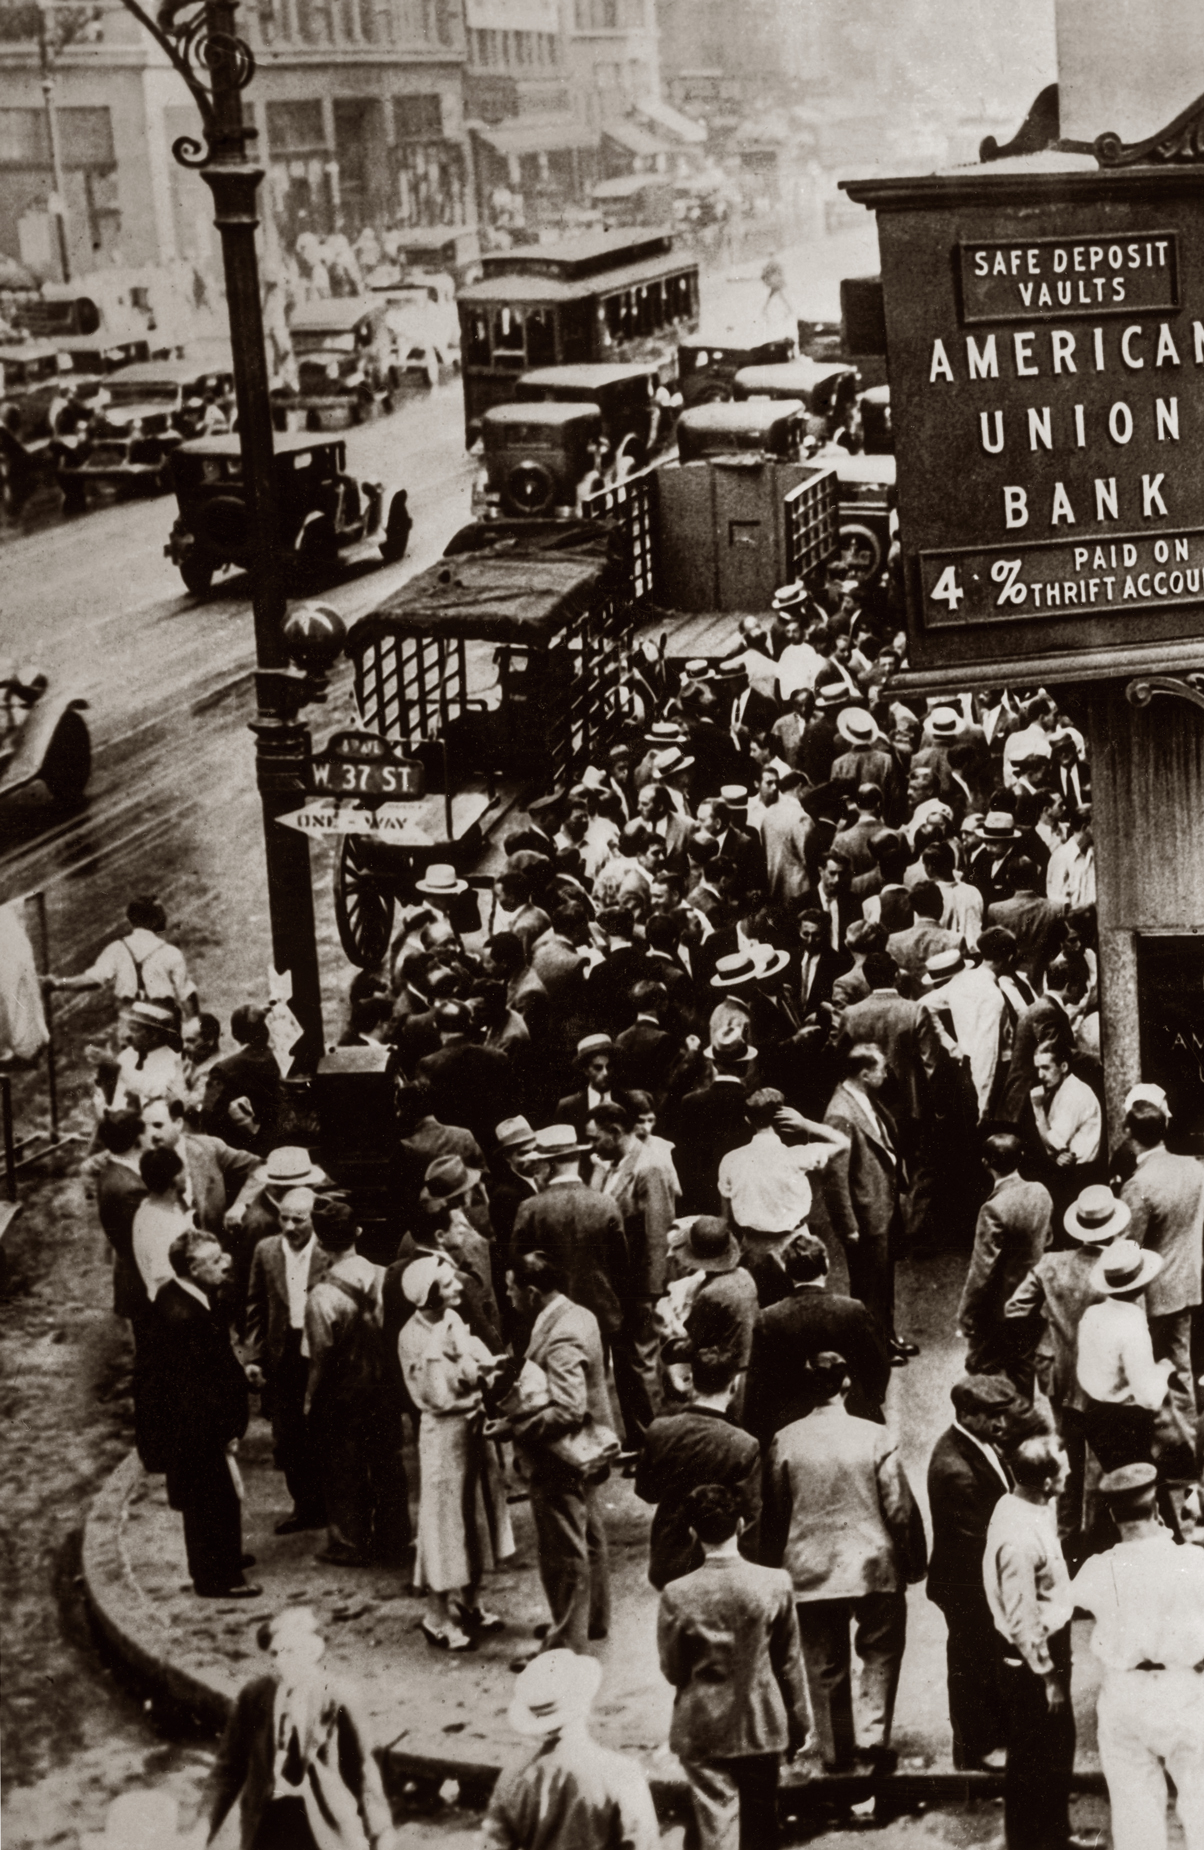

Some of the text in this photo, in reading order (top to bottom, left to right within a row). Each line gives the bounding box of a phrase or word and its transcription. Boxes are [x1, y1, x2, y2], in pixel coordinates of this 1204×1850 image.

[975, 241, 1168, 276] SAFE DEPOSIT
[1019, 277, 1125, 306] VAULTS
[980, 397, 1180, 453] UNION
[1003, 473, 1168, 529] BANK
[1074, 538, 1189, 571] PAID ON
[930, 565, 964, 610] 4
[1030, 576, 1117, 607] THRIFT
[342, 764, 371, 791] 37
